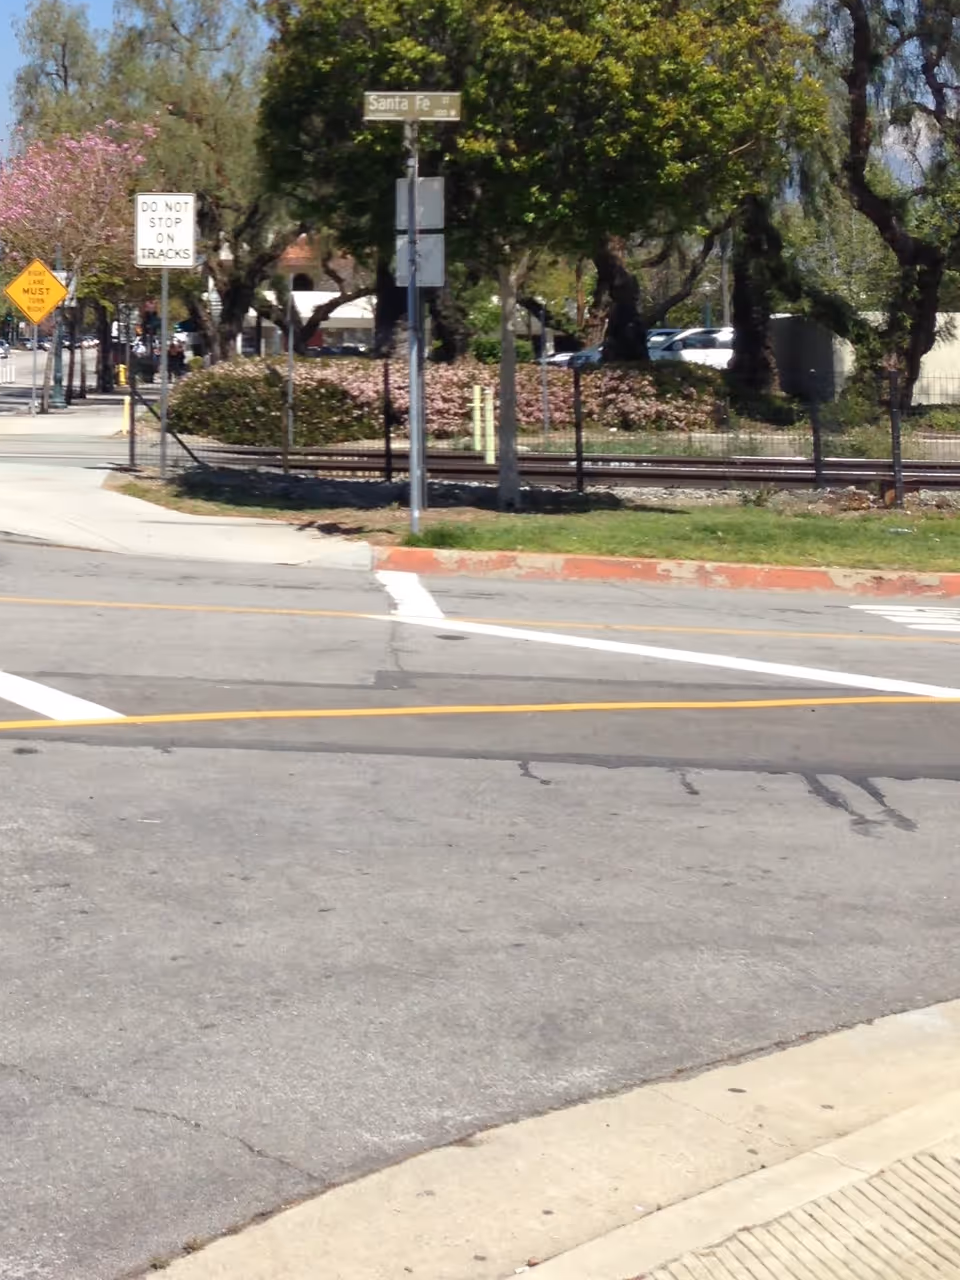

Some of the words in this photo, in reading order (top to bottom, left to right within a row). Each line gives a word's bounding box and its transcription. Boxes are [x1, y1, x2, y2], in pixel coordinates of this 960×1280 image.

[368, 95, 409, 111] Santa
[415, 95, 431, 111] Fe
[141, 201, 158, 213] DO
[165, 201, 190, 213] NOT
[149, 217, 183, 228] STOP
[156, 232, 175, 244] ON
[140, 248, 191, 260] TRACKS
[22, 287, 51, 296] MUST
